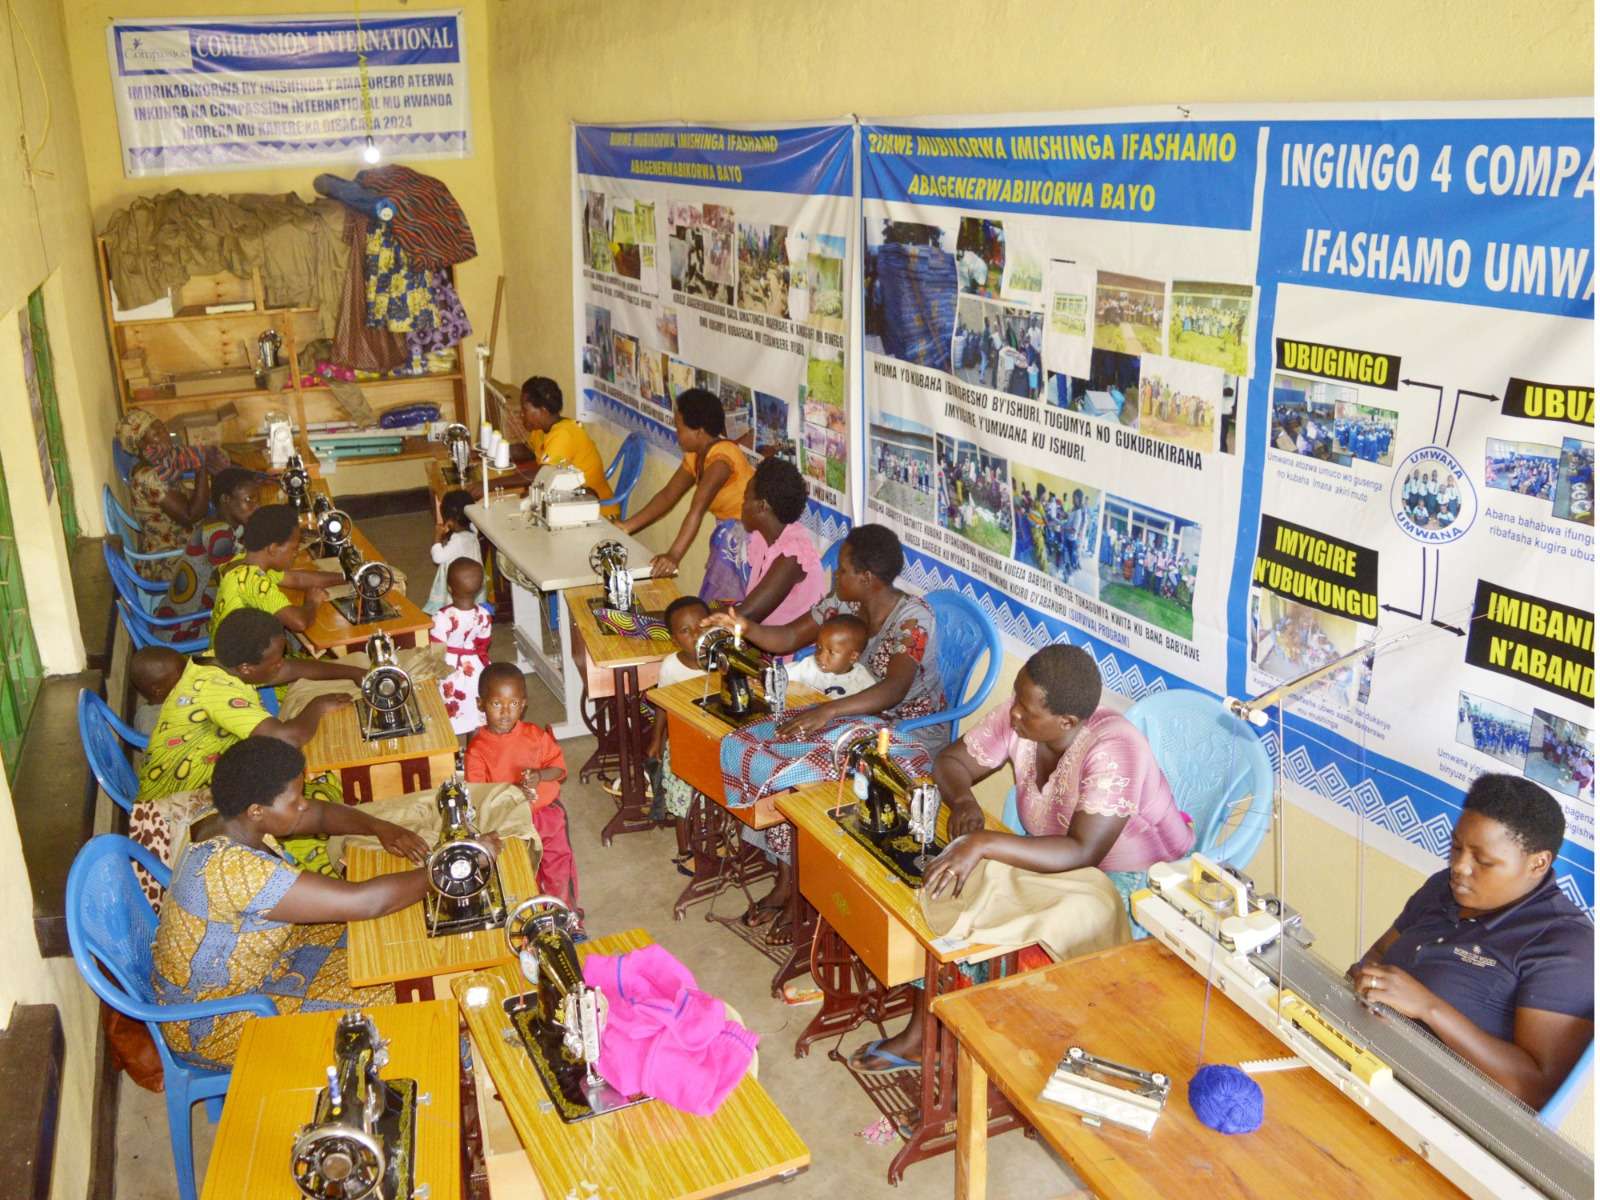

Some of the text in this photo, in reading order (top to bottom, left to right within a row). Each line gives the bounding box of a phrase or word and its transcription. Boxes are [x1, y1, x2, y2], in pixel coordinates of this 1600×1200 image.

[194, 27, 453, 58] COMPASSION INTERNATIONAL
[408, 71, 454, 88] ATERWA
[210, 101, 288, 118] COMPASSION
[404, 93, 453, 109] RWANDA
[237, 122, 255, 137] MU
[384, 114, 413, 129] 2024
[678, 132, 724, 151] IMISHINGA
[728, 135, 778, 153] IFASHAMO
[917, 135, 1008, 160] MUBIKORWA
[1011, 134, 1115, 161] IMISHINGA
[1122, 132, 1237, 163] IFASHAMO
[718, 164, 743, 183] BAYO
[1281, 143, 1420, 193] INGINGO
[1431, 145, 1452, 193] 4
[908, 173, 1156, 212] ABAGENERWABIKORWA BAYO
[1302, 228, 1472, 288] IFASHAMO
[1284, 341, 1388, 385] UBUGINGO
[874, 361, 897, 379] NYUMA
[1045, 409, 1092, 439] TUGUMYA
[1097, 424, 1110, 444] NO
[1116, 430, 1203, 471] GUKURIKIRANA
[979, 415, 1027, 446] Y'UMWANA
[1032, 431, 1045, 450] KU
[1050, 437, 1086, 463] ISHURI.
[1410, 450, 1463, 480] UMWANA
[1397, 511, 1463, 541] UMWANA
[1485, 507, 1595, 546] Abana bahabwa ifung
[1489, 525, 1532, 546] ribafasha
[1534, 537, 1567, 555] kugira
[1275, 526, 1357, 577] IMYIGIRE
[1254, 556, 1377, 619] N'UBUKUNGU
[1111, 611, 1131, 630] KWITA
[1134, 621, 1143, 637] KU
[1145, 626, 1163, 646] BANA
[1165, 636, 1200, 662] BABYAWE
